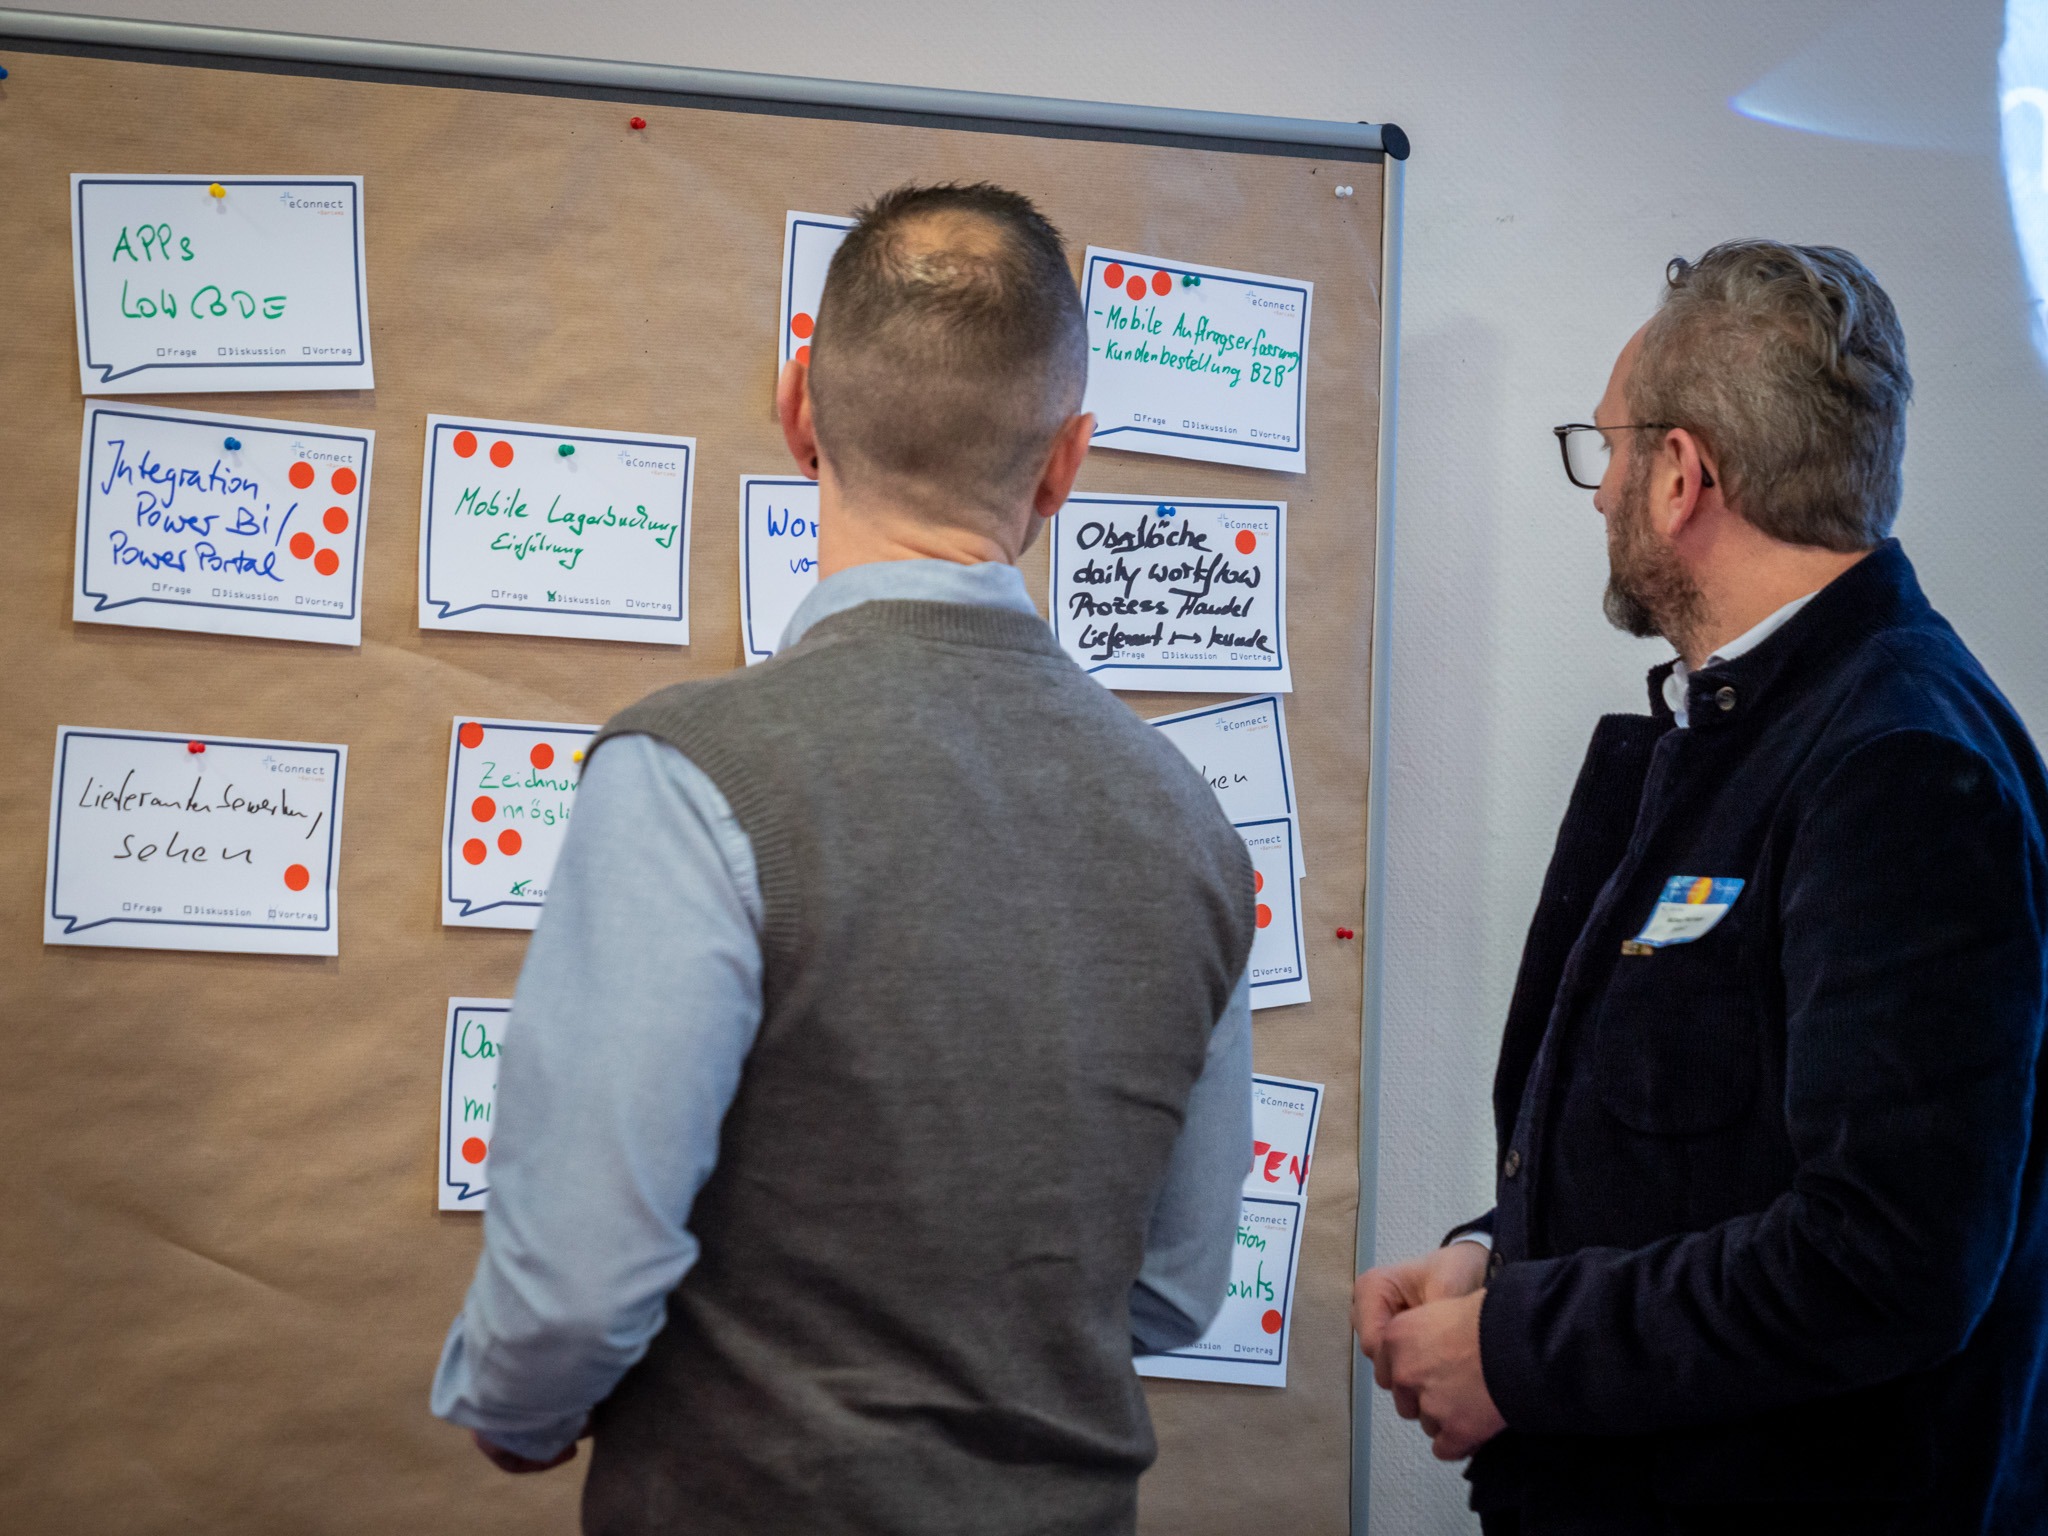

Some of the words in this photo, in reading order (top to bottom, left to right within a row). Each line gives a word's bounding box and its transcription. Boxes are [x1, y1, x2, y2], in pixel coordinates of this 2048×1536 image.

[289, 199, 343, 209] eConnect
[1252, 299, 1296, 312] eConnect
[167, 348, 197, 358] Frage
[228, 346, 286, 356] Diskussion
[312, 346, 353, 356] Vortrag
[1105, 339, 1242, 388] Kundenbestellung
[1250, 361, 1286, 388] B2B
[1143, 415, 1166, 425] Frage
[1191, 421, 1237, 434] Diskussion
[1259, 430, 1291, 442] Vortrag
[299, 450, 353, 463] eConnect
[625, 459, 676, 470] eConnect
[101, 439, 259, 508] Integration
[454, 486, 529, 518] Mobile
[136, 491, 219, 537] Power
[1225, 521, 1269, 530] eConnect
[109, 530, 187, 572] Power
[194, 541, 284, 582] Portal
[490, 532, 584, 570] Einführung
[1072, 557, 1141, 599] daily
[162, 584, 192, 594] Frage
[223, 589, 279, 602] Diskussion
[500, 591, 528, 600] Frage
[557, 594, 611, 606] Diskussion
[305, 597, 344, 609] Vortrag
[635, 600, 672, 612] Vortrag
[1121, 651, 1145, 660] Frage
[1171, 652, 1217, 660] Diskussion
[1239, 653, 1272, 662] Vortrag
[1223, 715, 1268, 732] eConnect
[271, 762, 325, 775] eConnect
[133, 903, 162, 914] Frage
[194, 905, 252, 916] Diskussion
[278, 910, 318, 921] Vortrag
[1261, 966, 1292, 977] Vortrag
[1260, 1096, 1305, 1111] eConnect
[1243, 1213, 1288, 1226] eConnect
[1242, 1345, 1273, 1355] Vortrag
